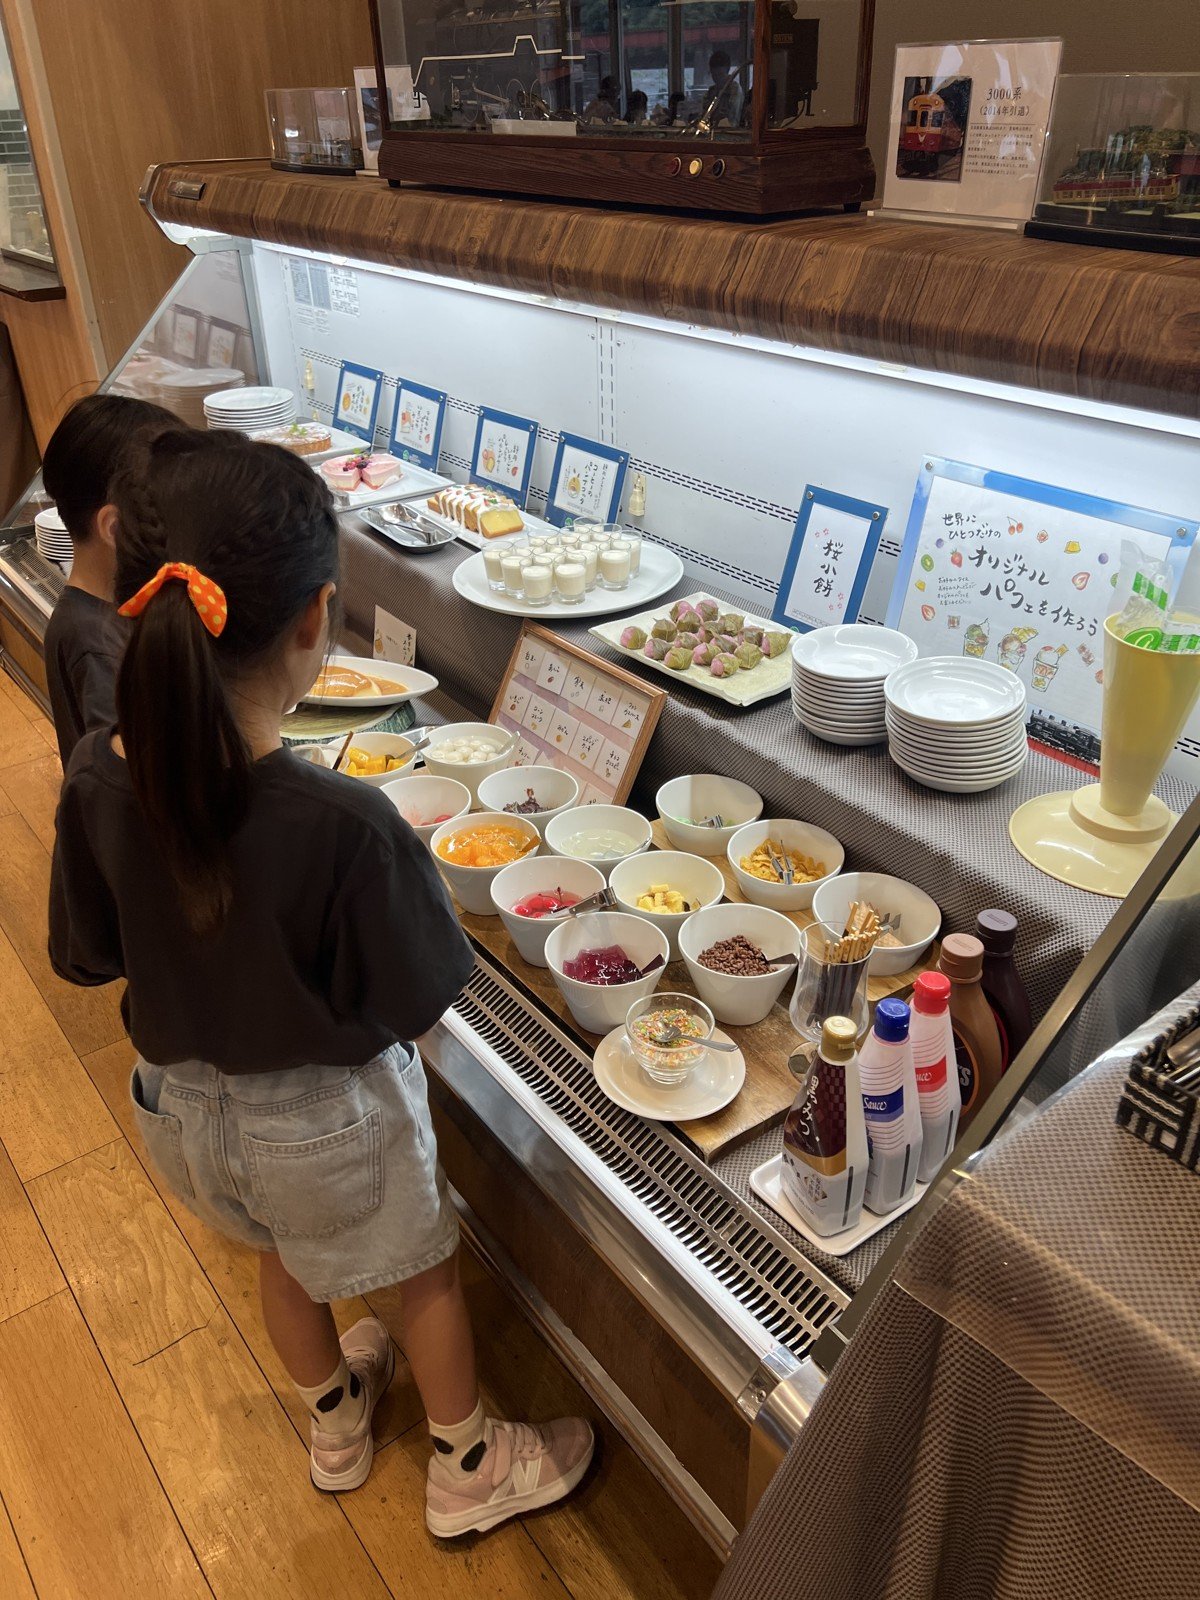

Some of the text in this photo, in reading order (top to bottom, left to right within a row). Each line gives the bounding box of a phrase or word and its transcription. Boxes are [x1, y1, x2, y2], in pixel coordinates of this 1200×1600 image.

[986, 86, 1022, 101] 3000系
[942, 511, 977, 527] 世界に
[948, 522, 1001, 540] ひとつだけの
[813, 539, 844, 598] 桜小餅
[968, 545, 1050, 587] オリジナル
[980, 578, 1098, 637] パフェを作ろう
[916, 1072, 933, 1082] uce
[863, 1097, 887, 1111] Sauce
